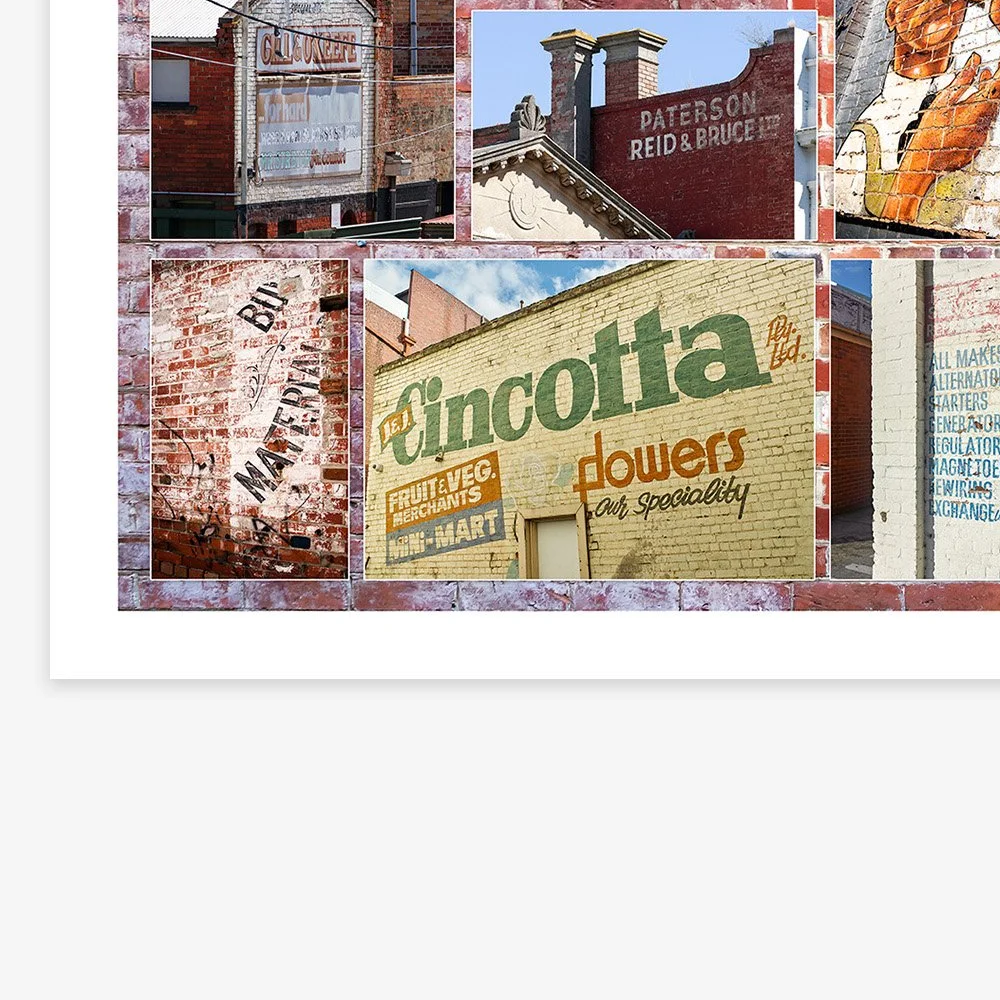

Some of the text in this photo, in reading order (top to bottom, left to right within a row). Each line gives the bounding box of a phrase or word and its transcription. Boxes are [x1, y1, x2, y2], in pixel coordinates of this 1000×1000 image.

[640, 91, 756, 132] PATERSON
[630, 133, 677, 161] REID
[680, 133, 692, 152] &
[696, 118, 755, 150] BRUCE
[929, 351, 951, 371] ALL
[391, 308, 772, 466] Cincotta
[928, 391, 989, 412] STARTERS
[388, 476, 438, 513] FRUIT
[446, 459, 497, 492] VEG.
[392, 485, 482, 527] MERCHANTS
[929, 478, 993, 500] REWIRING
[929, 499, 995, 522] EXCHANGE
